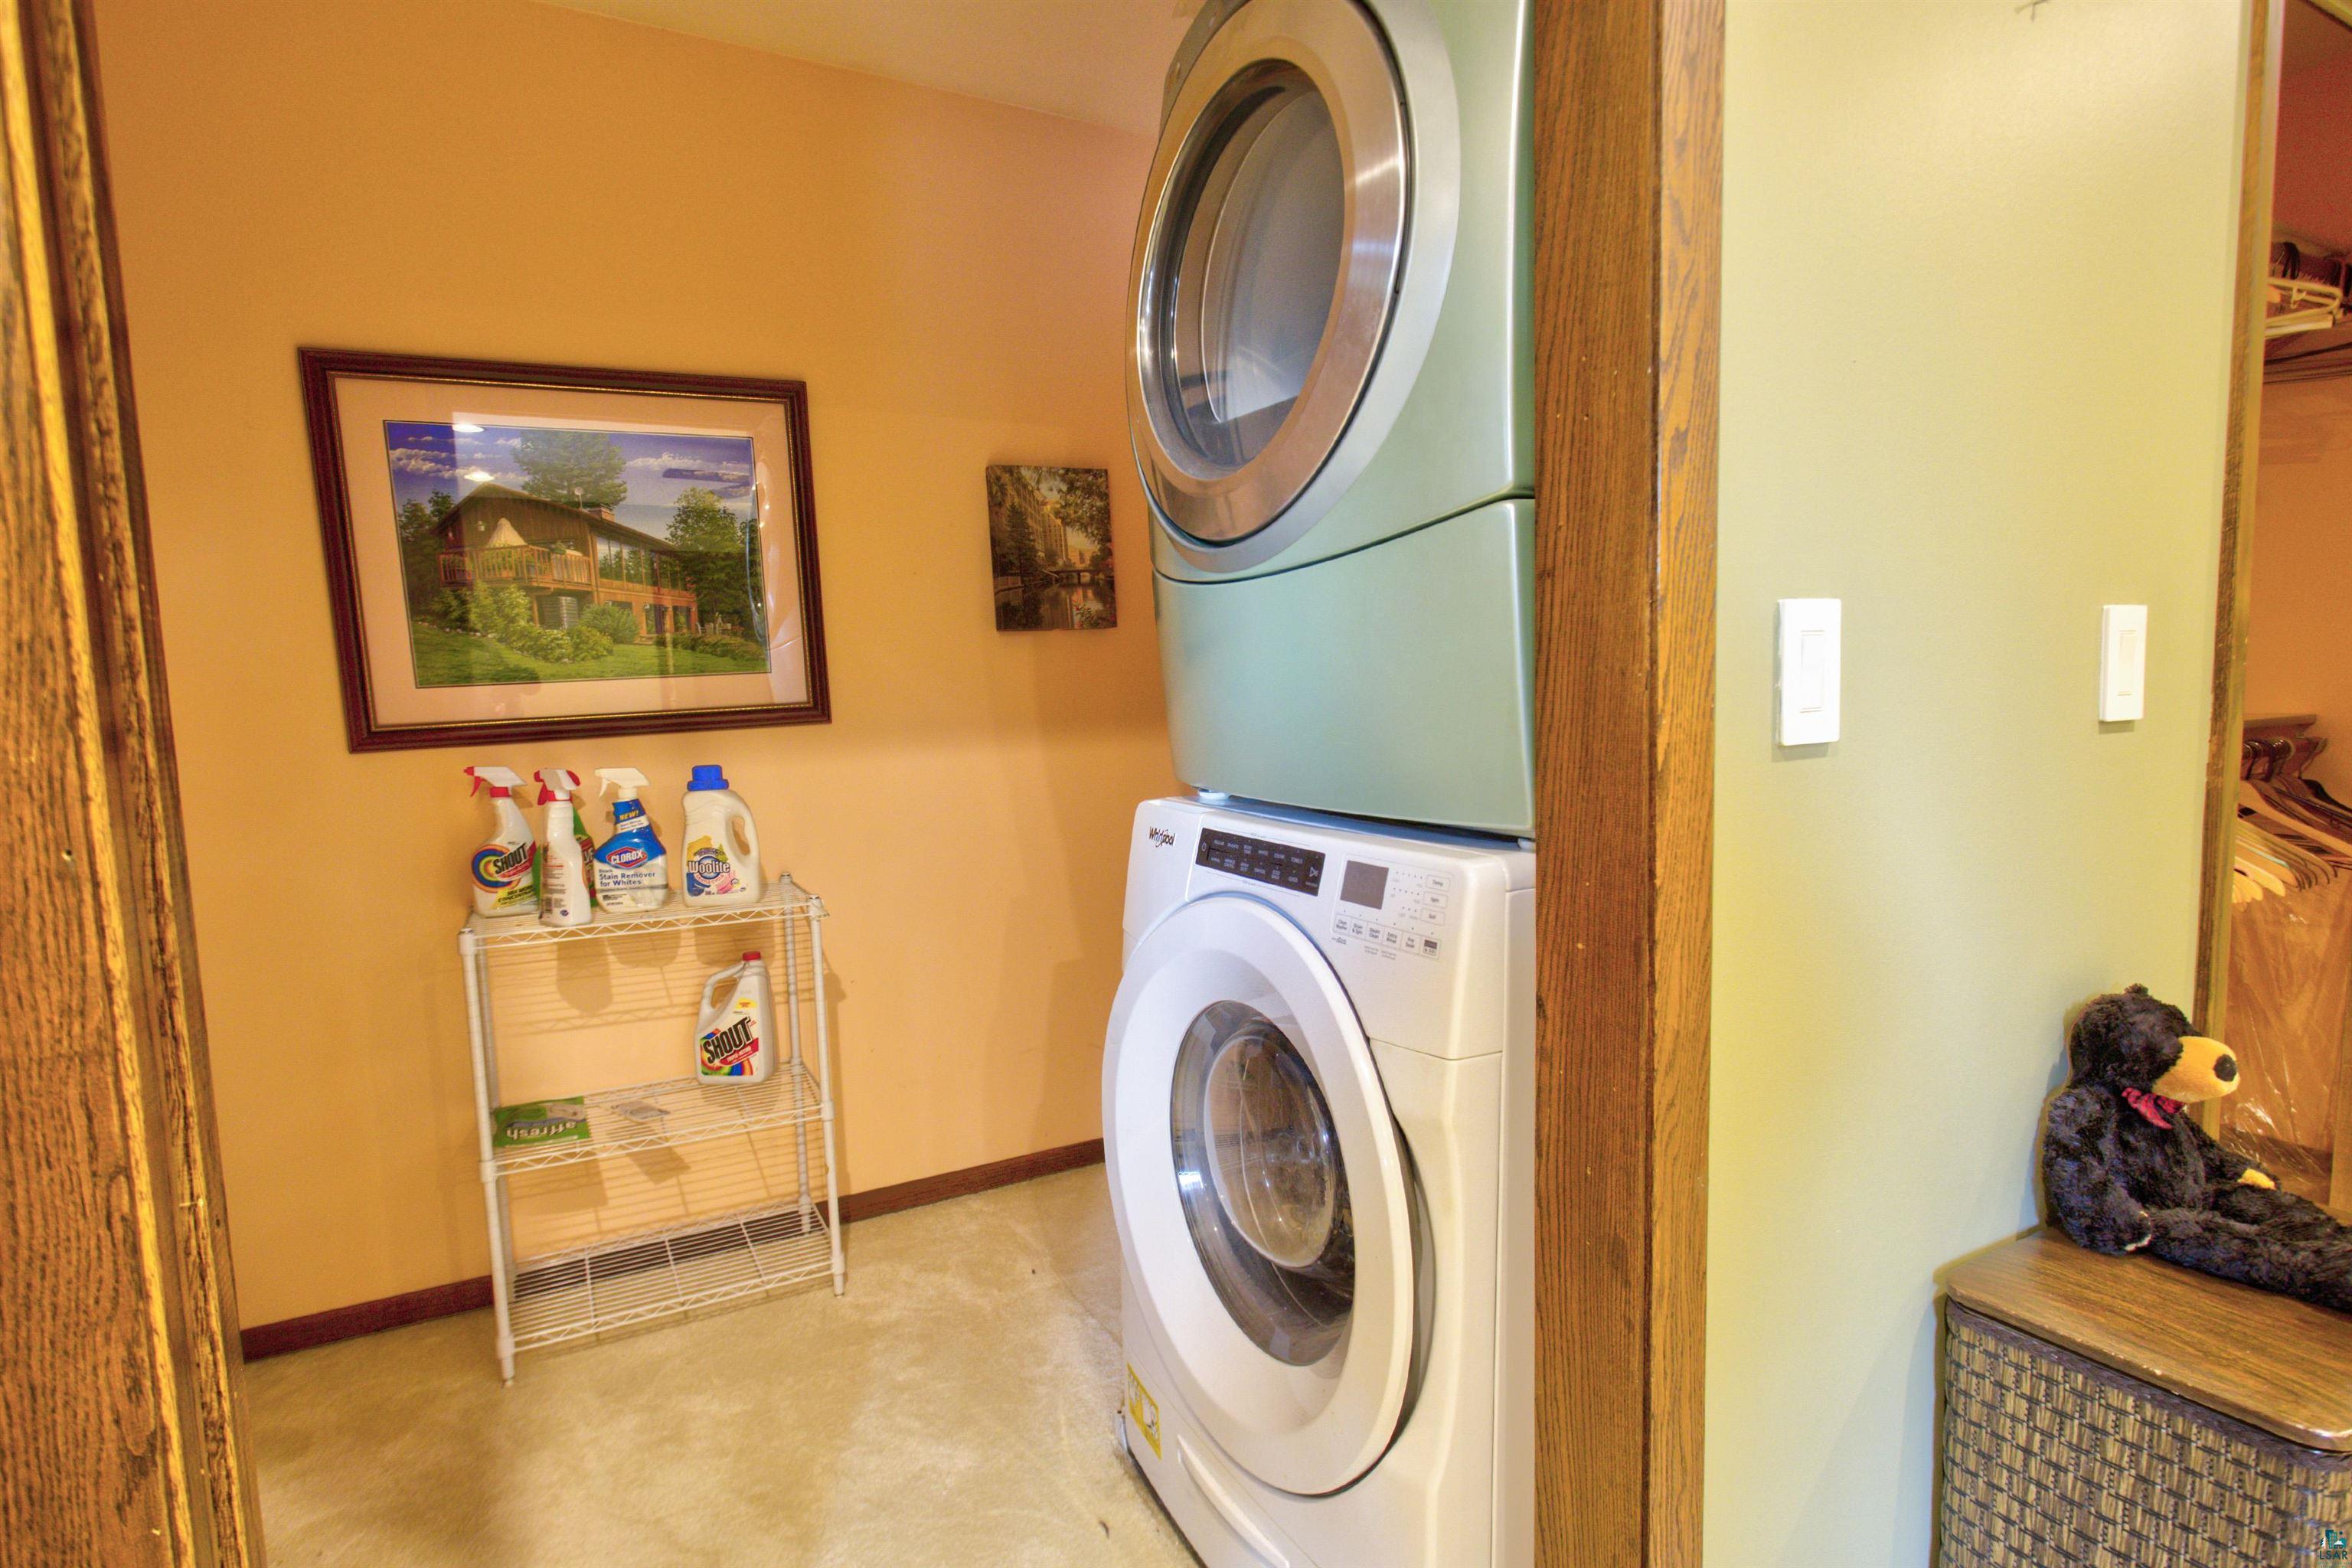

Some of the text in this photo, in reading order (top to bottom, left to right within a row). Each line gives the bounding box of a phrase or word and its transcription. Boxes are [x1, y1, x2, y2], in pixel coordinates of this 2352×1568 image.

[619, 810, 639, 821] NEW!
[1149, 827, 1175, 847] Whirlpool
[492, 842, 528, 874] SHOUT
[611, 851, 643, 864] CLOROX
[688, 860, 730, 874] Woolite
[702, 1017, 752, 1064] SHOUT
[506, 1121, 577, 1140] affresh
